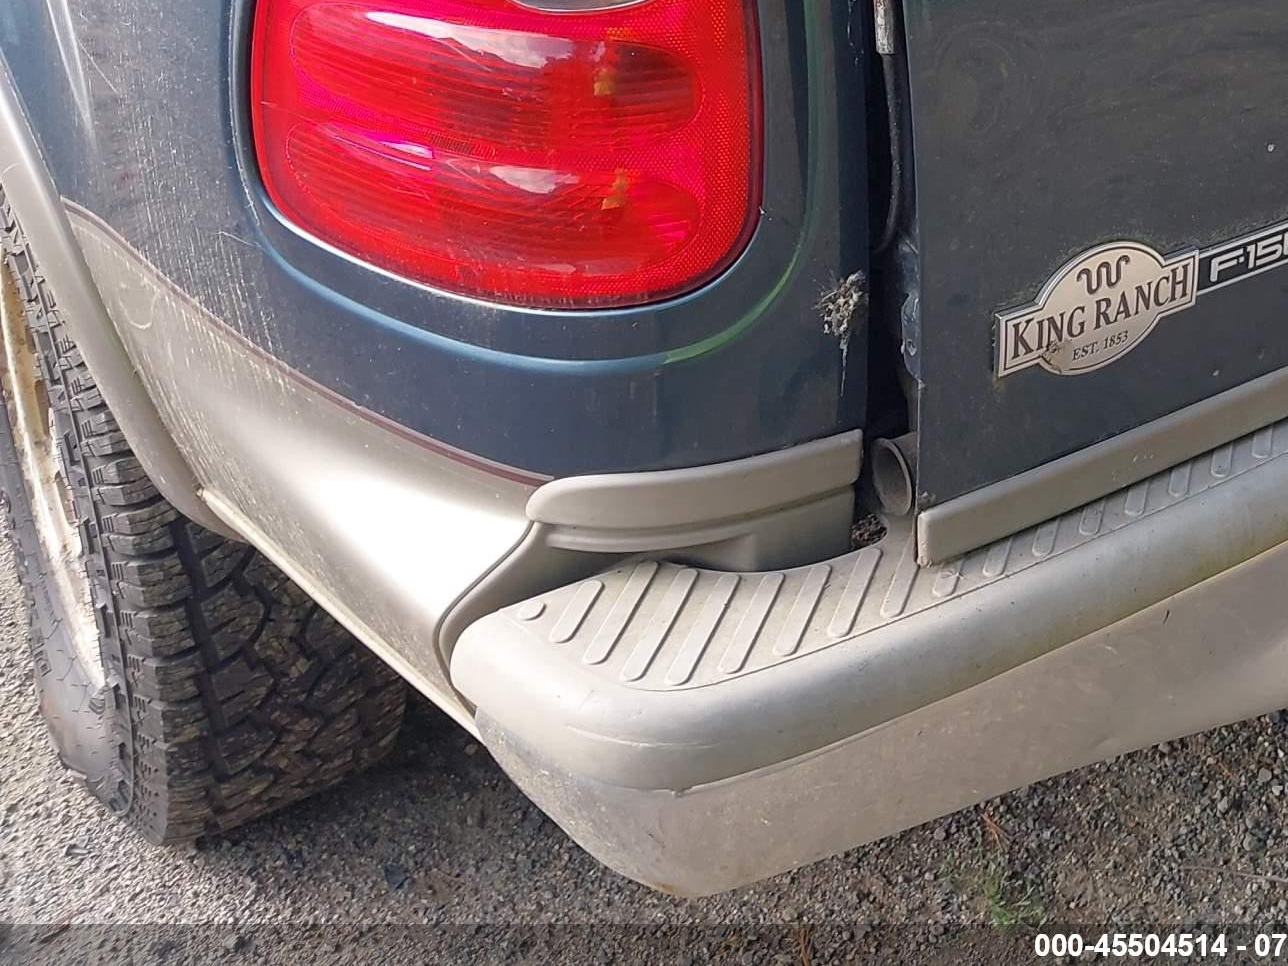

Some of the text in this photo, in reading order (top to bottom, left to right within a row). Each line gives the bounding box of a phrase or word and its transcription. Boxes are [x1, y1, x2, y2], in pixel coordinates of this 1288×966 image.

[1010, 263, 1191, 361] KING RANCH
[1072, 330, 1129, 361] EST. 1853
